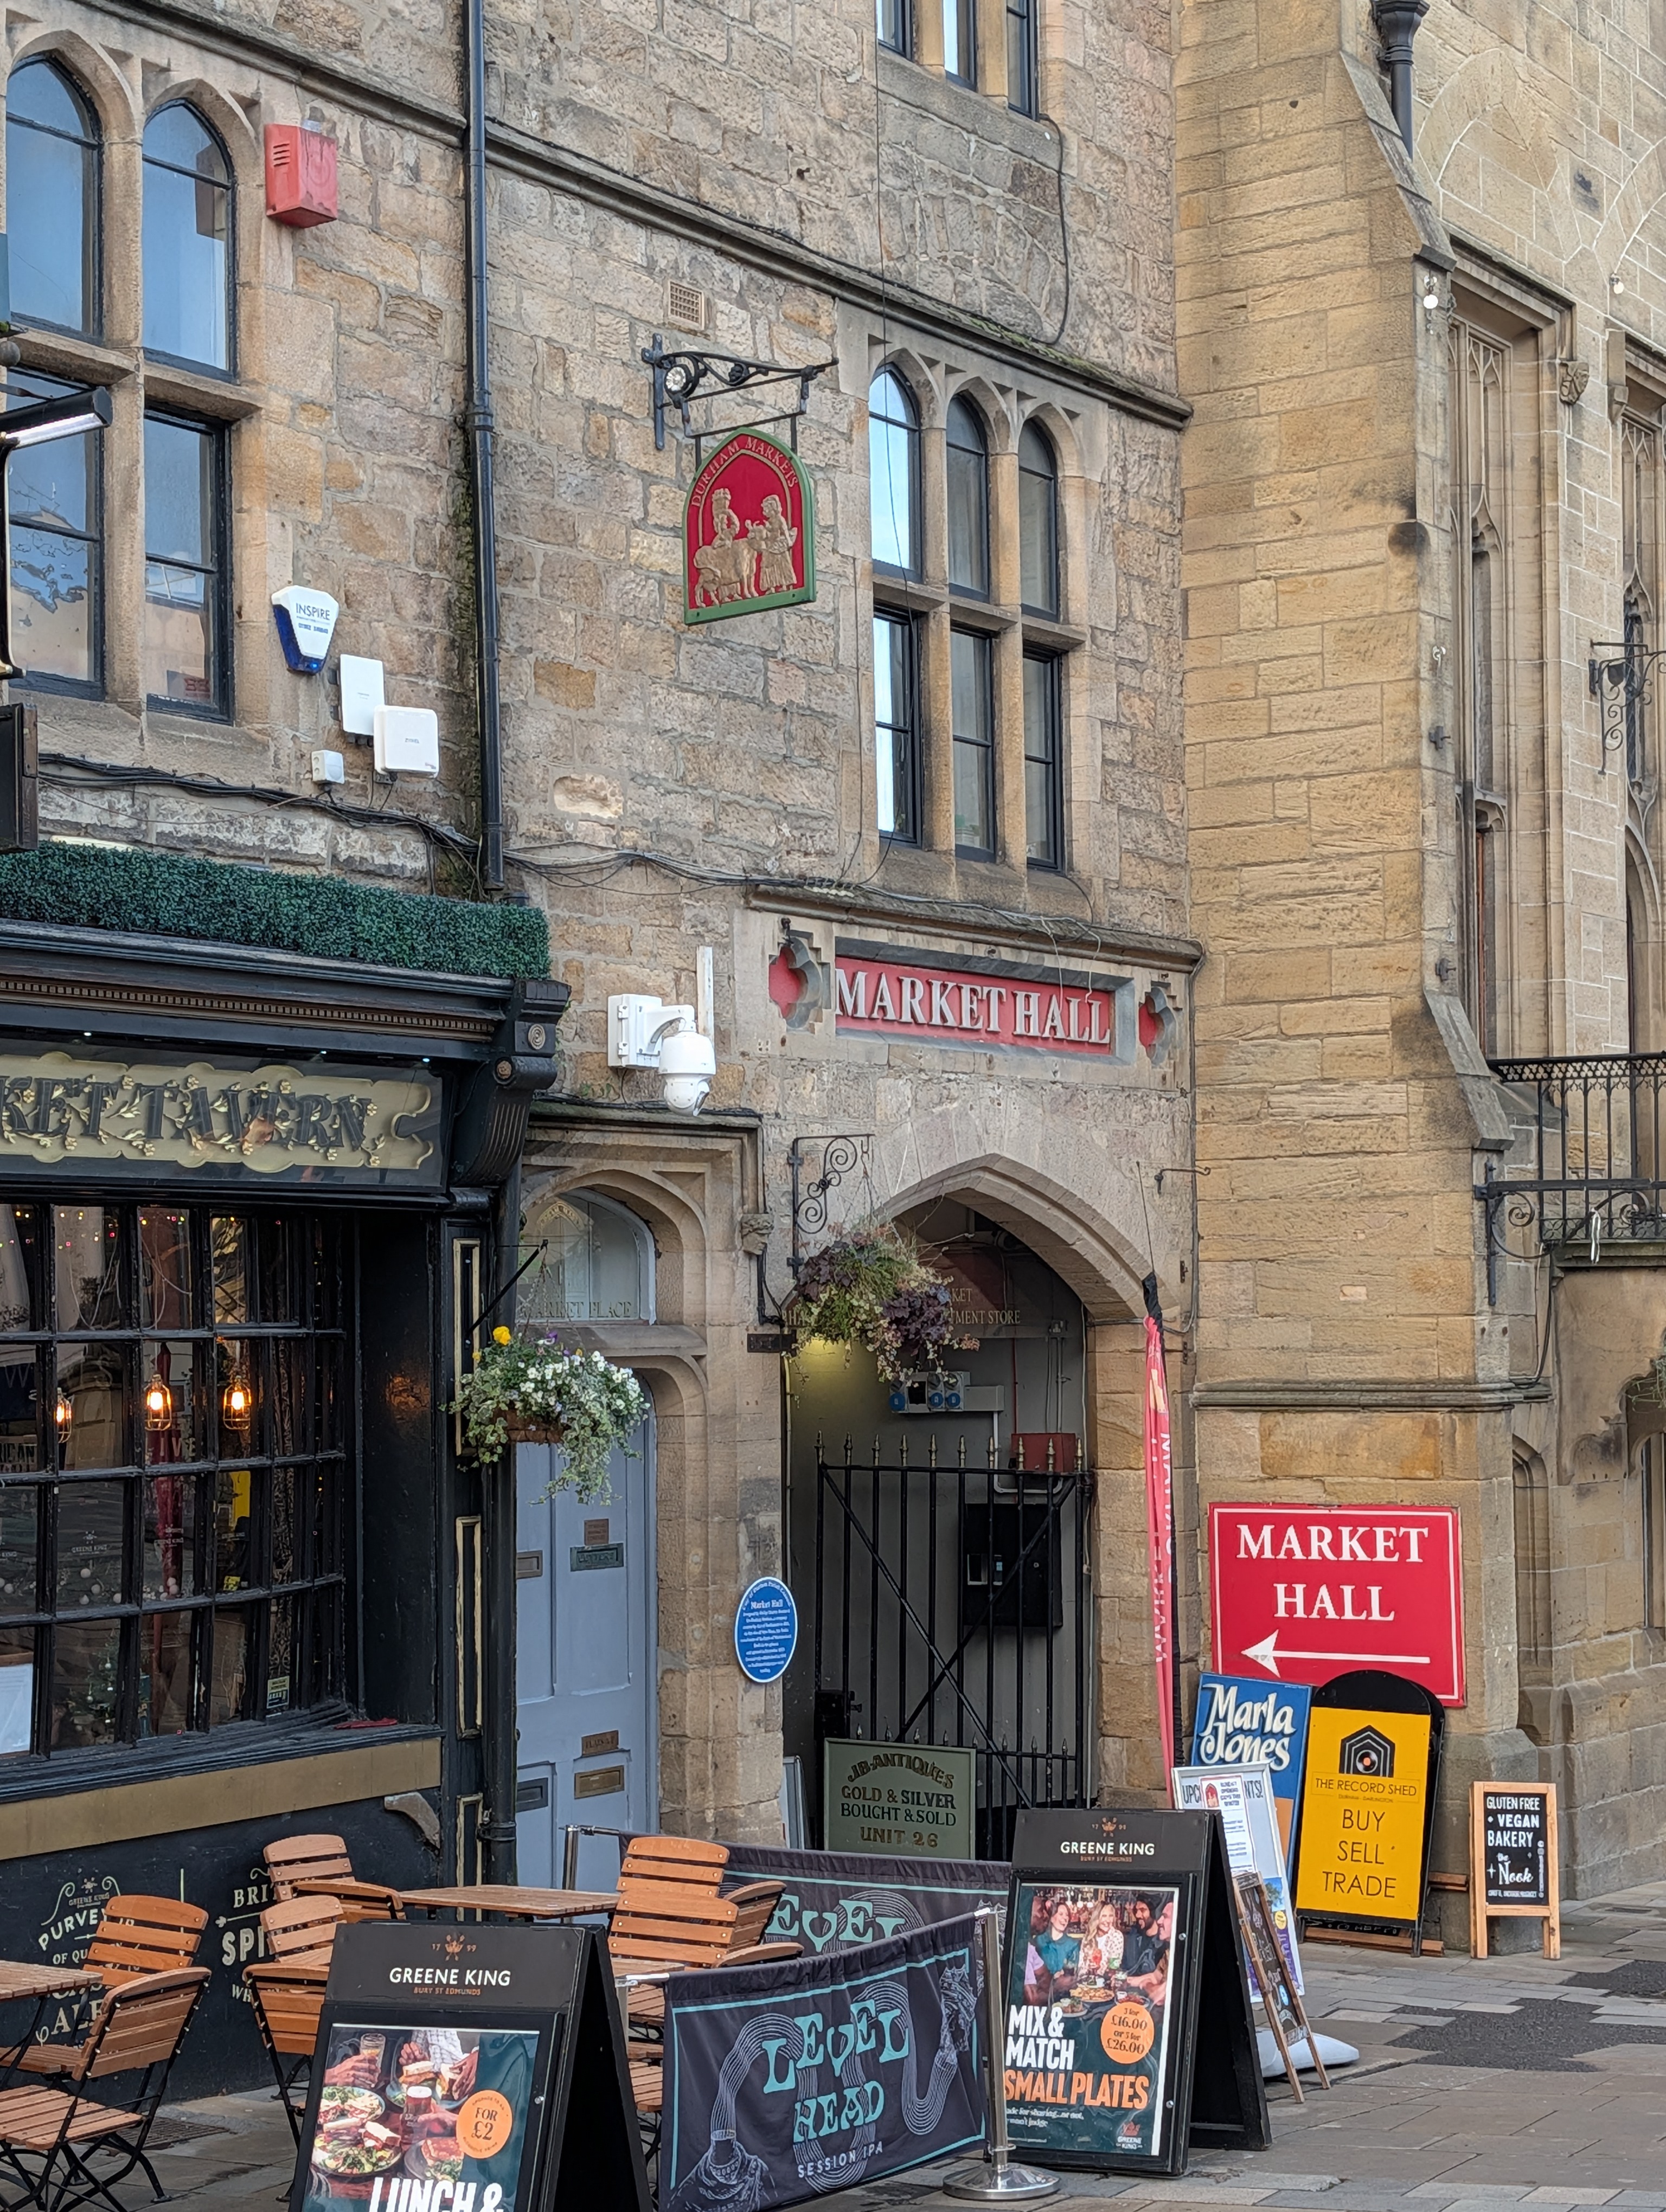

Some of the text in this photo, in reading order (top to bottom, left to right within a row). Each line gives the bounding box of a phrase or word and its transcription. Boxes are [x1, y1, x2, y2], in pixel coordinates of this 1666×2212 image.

[691, 436, 798, 506] DURHAM MARKETS
[296, 603, 330, 620] INSPIRE
[836, 969, 1110, 1044] MARKET HALL
[137, 1084, 373, 1153] TAVERN
[952, 1288, 972, 1301] KET
[589, 1302, 631, 1317] PLACE
[950, 1310, 1020, 1323] TMENT STORE
[1236, 1525, 1428, 1562] MARKET
[1273, 1583, 1395, 1621] HALL
[1199, 1683, 1297, 1737] Marla
[1200, 1722, 1290, 1771] Jones
[872, 1753, 954, 1789] ANTIQUES
[841, 1786, 956, 1810] GOLD & SILVER
[1316, 1778, 1417, 1796] THE RECORD SHED
[841, 1803, 956, 1826] BOUGHT & SOLD
[1486, 1796, 1540, 1811] GLUTEN FREE
[1342, 1809, 1385, 1832] BUY
[1497, 1814, 1539, 1828] VEGAN
[860, 1827, 938, 1848] UNIT 26
[1061, 1842, 1155, 1855] GREENE KING
[1488, 1830, 1533, 1848] BAKERY
[1337, 1841, 1384, 1864] SELL
[1322, 1872, 1396, 1898] TRADE
[1498, 1861, 1534, 1885] Nook
[765, 1894, 905, 1952] EVE
[222, 1925, 273, 1966] SPI
[389, 1967, 511, 1986] GREENE KING
[1008, 2005, 1063, 2038] MIX &
[1111, 2015, 1148, 2031] £16.00
[761, 1999, 909, 2094] LEVEL
[1005, 2036, 1074, 2070] MATCH
[1106, 2038, 1145, 2054] £26.00
[1003, 2072, 1149, 2109] SMALL PLATES
[476, 2107, 498, 2121] FOR
[793, 2081, 885, 2144] HEAD
[471, 2121, 494, 2140] £2
[798, 2140, 883, 2178] SESSION IPA
